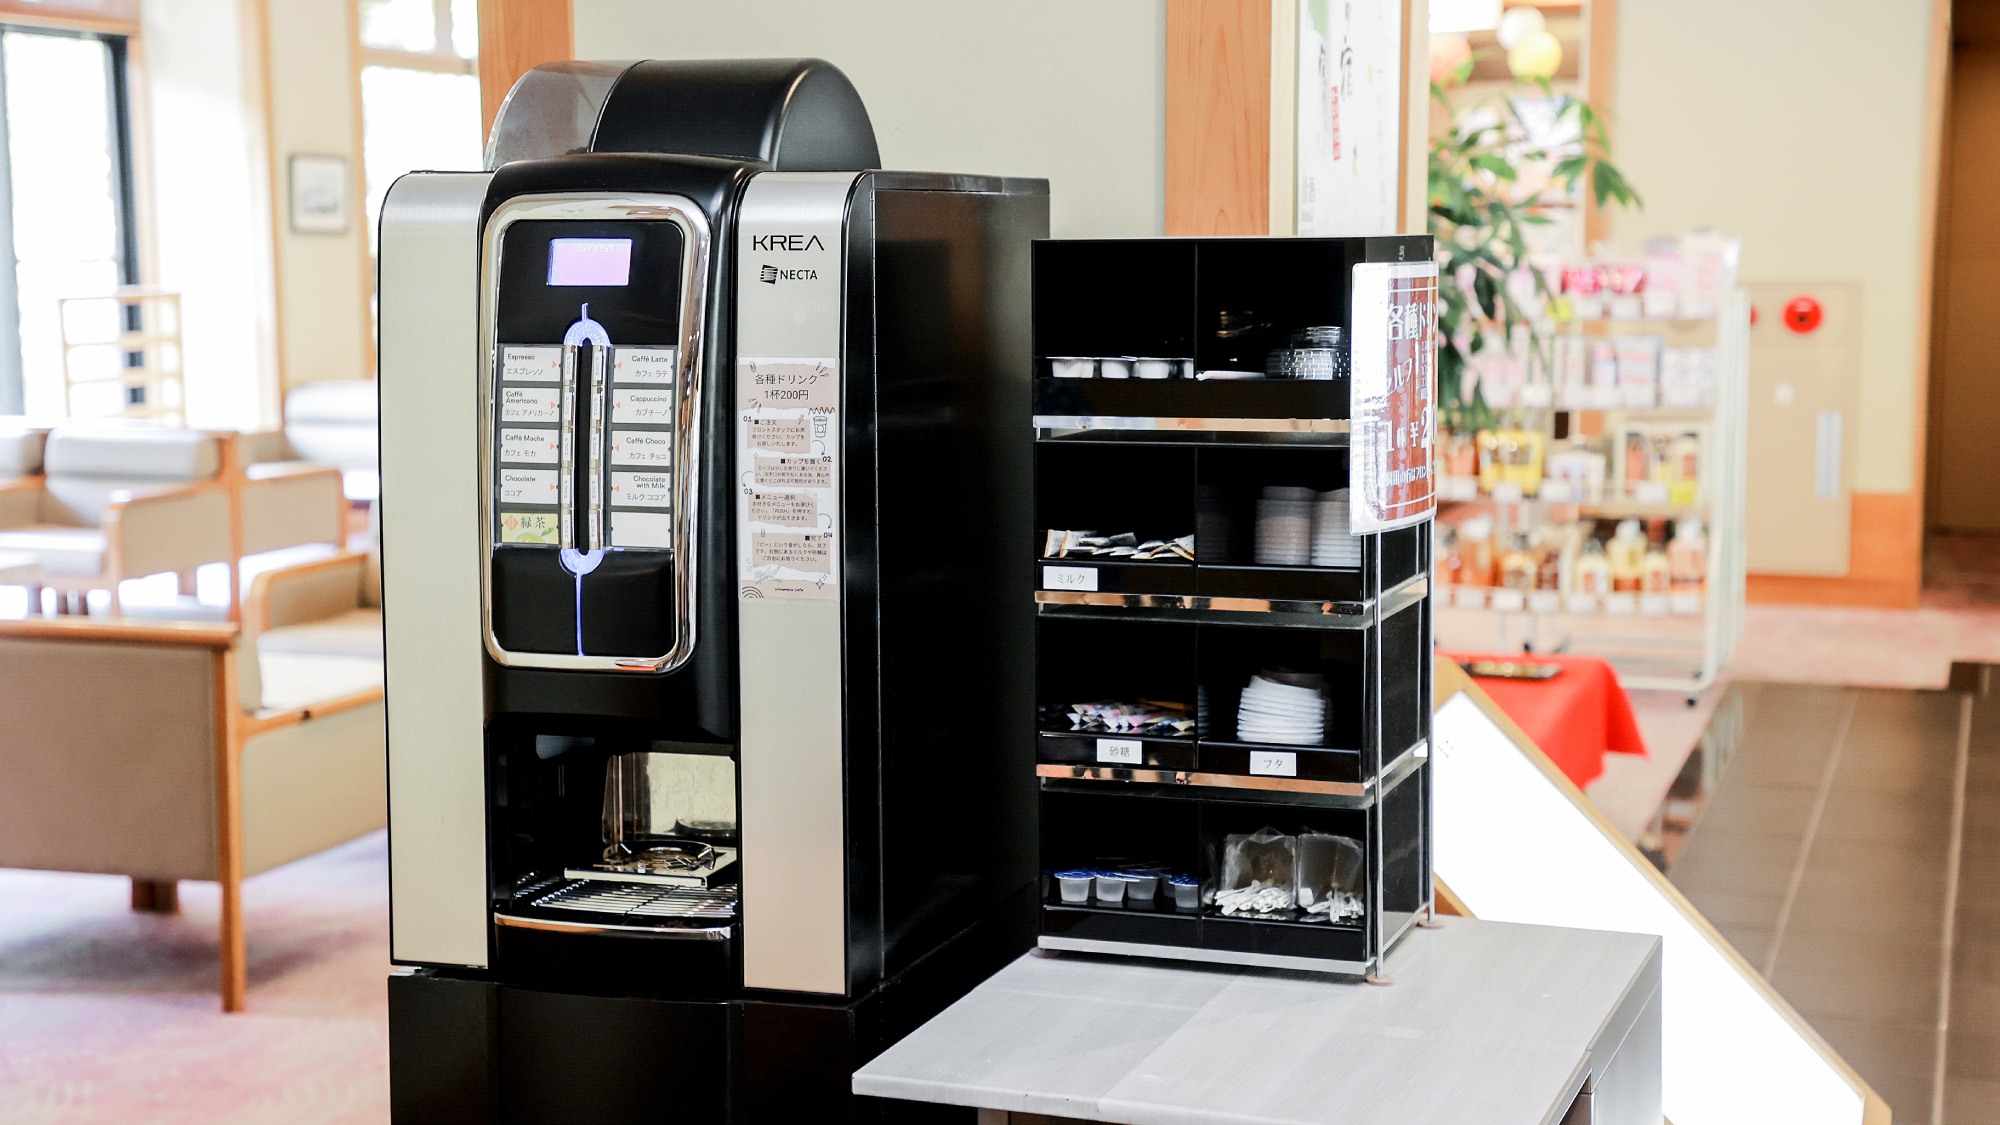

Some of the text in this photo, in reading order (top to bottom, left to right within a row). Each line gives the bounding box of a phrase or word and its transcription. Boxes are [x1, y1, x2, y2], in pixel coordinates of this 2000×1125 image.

[753, 235, 825, 251] KREA
[780, 270, 818, 280] NECTA
[506, 367, 543, 376] エスプレッソ
[656, 370, 668, 378] ラテ
[755, 374, 818, 385] 各種ドリンク
[630, 395, 667, 403] Cappuccino
[764, 389, 809, 400] 1杯200円
[635, 408, 668, 417] カプチーノ
[504, 449, 521, 457] カフェ
[629, 452, 646, 460] カフェ
[633, 475, 665, 483] Chocolate
[626, 492, 645, 501] ミルク
[520, 516, 545, 529] 緑茶
[1057, 573, 1085, 584] ミルク
[1109, 746, 1130, 758] 砂糖
[1263, 759, 1283, 769] フタ
